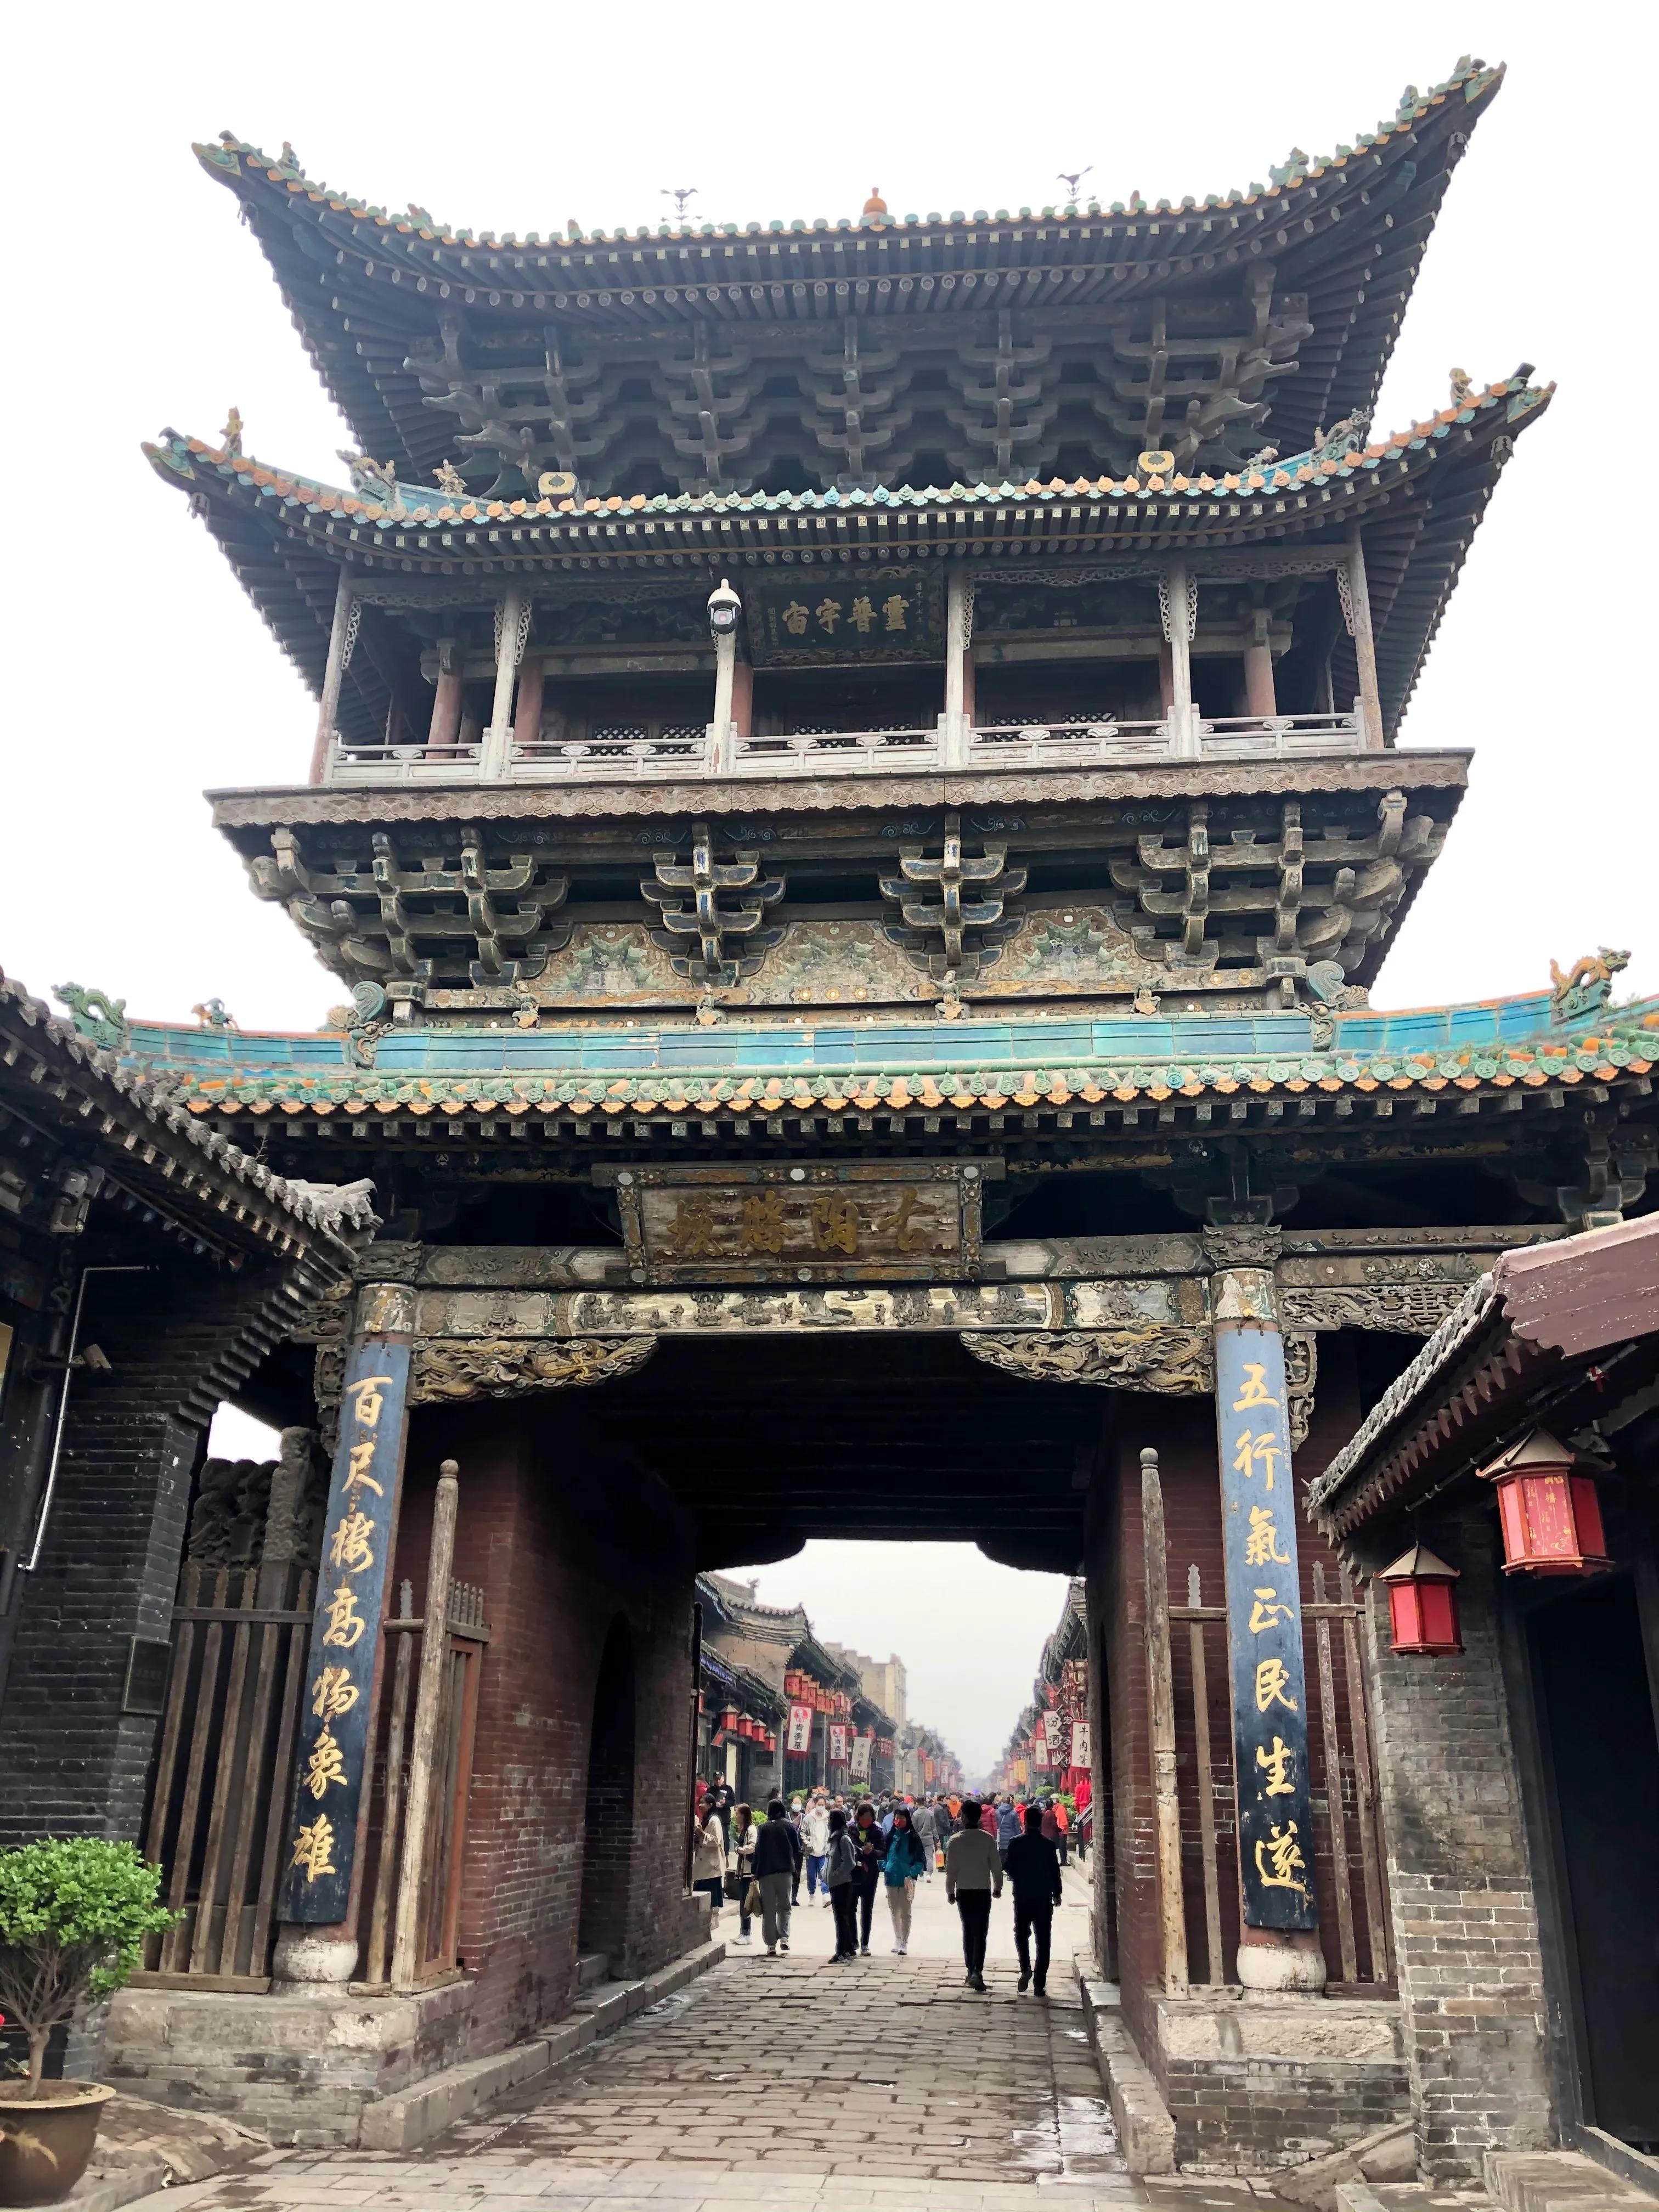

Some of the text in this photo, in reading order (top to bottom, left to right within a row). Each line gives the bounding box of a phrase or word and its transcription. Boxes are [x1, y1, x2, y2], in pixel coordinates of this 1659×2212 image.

[793, 1723, 804, 1750] 肯德基
[1046, 1716, 1061, 1746] 汾酒
